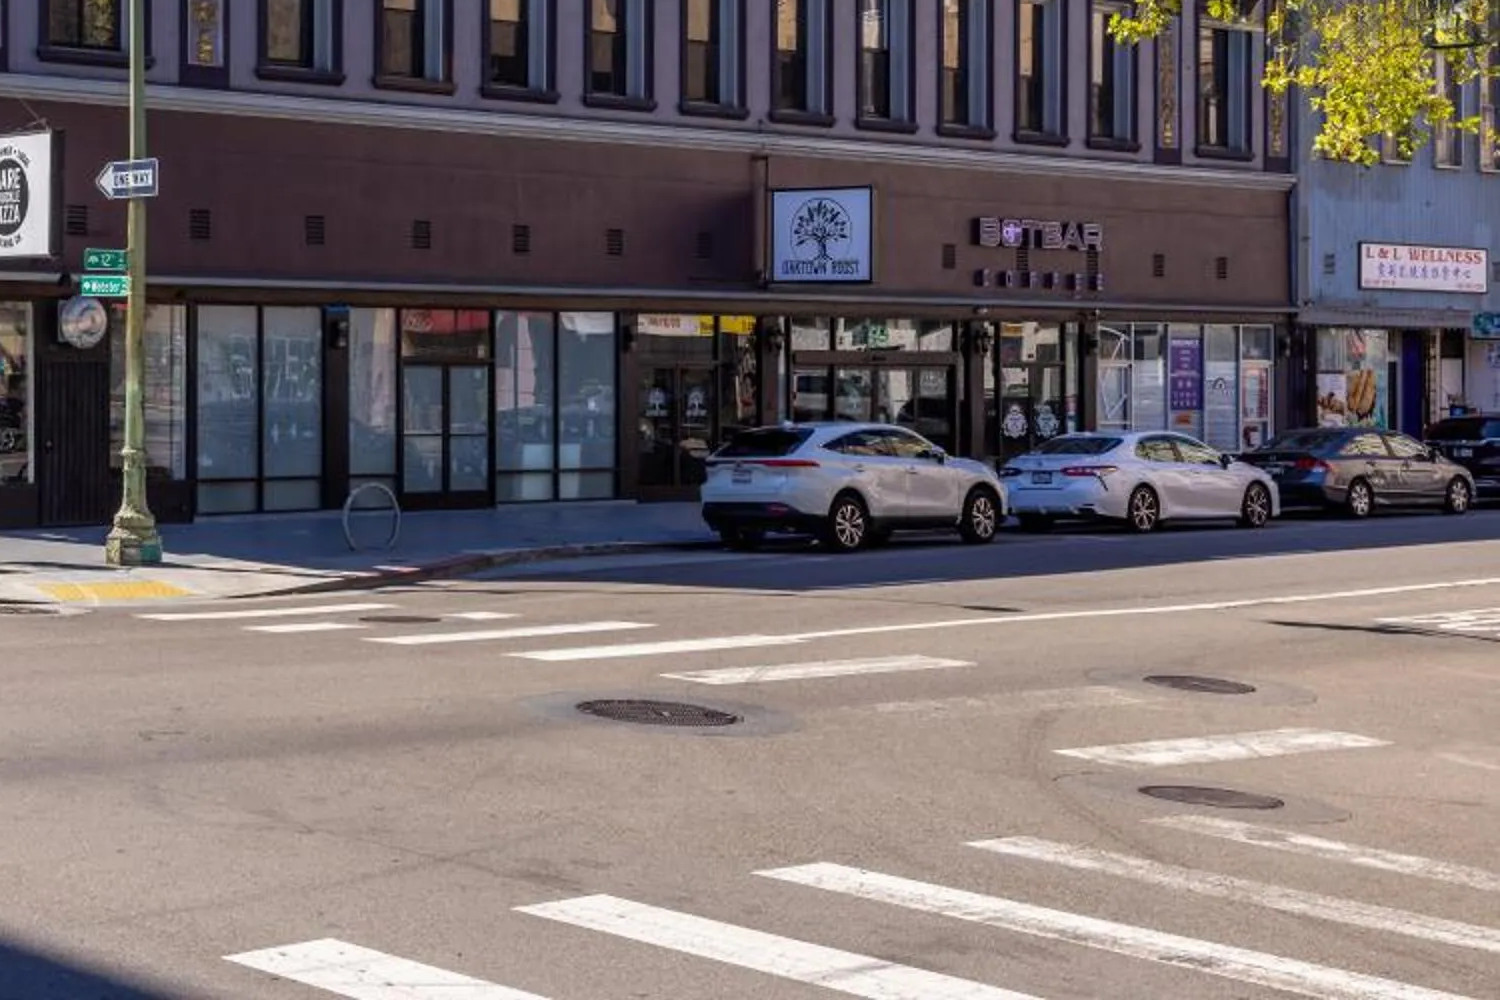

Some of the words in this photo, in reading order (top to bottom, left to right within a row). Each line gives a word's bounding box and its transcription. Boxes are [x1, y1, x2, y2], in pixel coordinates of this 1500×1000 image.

[113, 173, 130, 187] ONE
[132, 171, 151, 185] WAY
[1366, 246, 1375, 259] L
[1378, 247, 1390, 259] &
[1394, 247, 1402, 260] L
[1409, 247, 1483, 265] WELLNESS
[781, 260, 828, 276] OAKTOWN
[831, 259, 860, 276] ROOST
